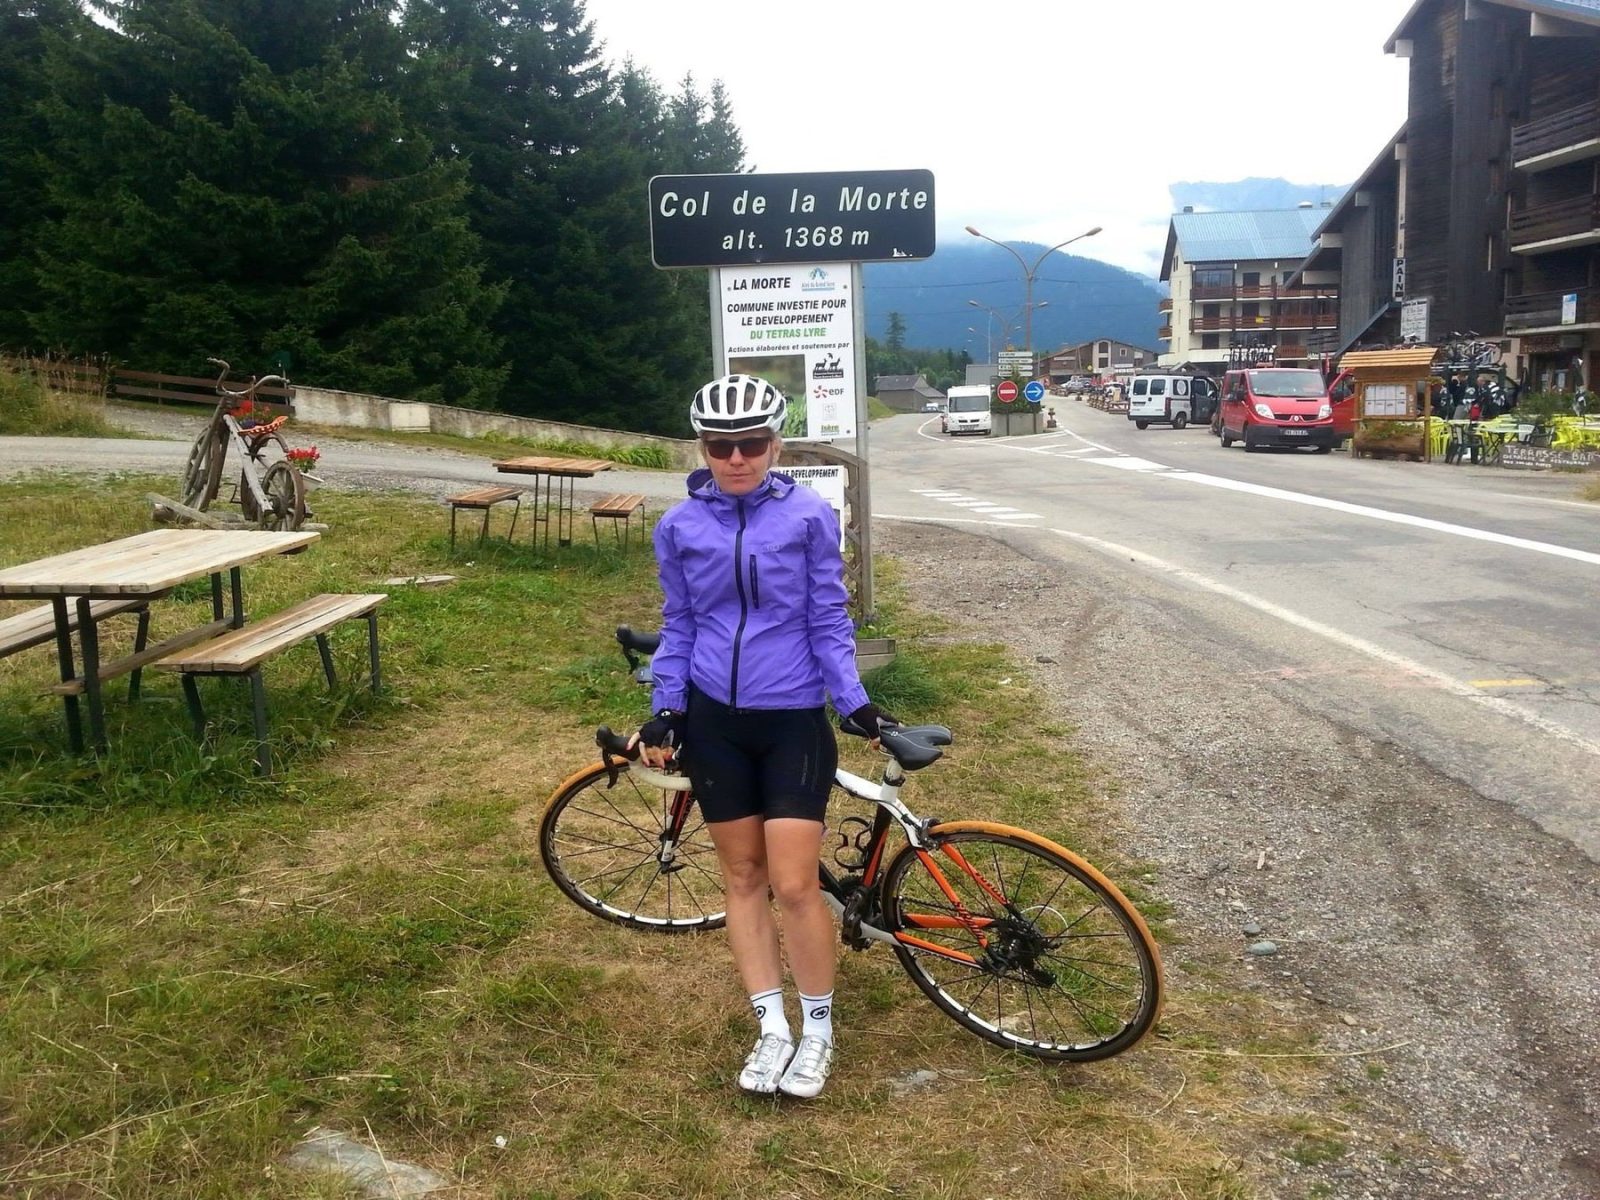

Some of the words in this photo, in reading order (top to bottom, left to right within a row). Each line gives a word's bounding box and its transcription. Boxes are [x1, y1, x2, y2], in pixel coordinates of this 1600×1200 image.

[660, 191, 709, 217] Col
[732, 190, 767, 215] de
[789, 188, 816, 213] la
[838, 186, 928, 212] Morte
[722, 229, 764, 250] alt.
[784, 226, 844, 248] 1368
[851, 229, 870, 246] m
[1396, 260, 1404, 291] PAIN
[733, 279, 748, 290] LA
[751, 277, 791, 290] MORTE
[727, 302, 774, 313] COMMUNE
[776, 300, 819, 311] INVESTIE
[821, 299, 847, 309] POUR
[741, 317, 753, 326] LE
[755, 313, 834, 326] DEVELOPPEMENT
[750, 330, 763, 340] DU
[766, 328, 801, 339] TETRAS
[803, 327, 827, 337] LYRE
[756, 344, 790, 352] élaborées
[837, 342, 850, 350] par
[791, 468, 839, 479] DEVELOPPEMENT
